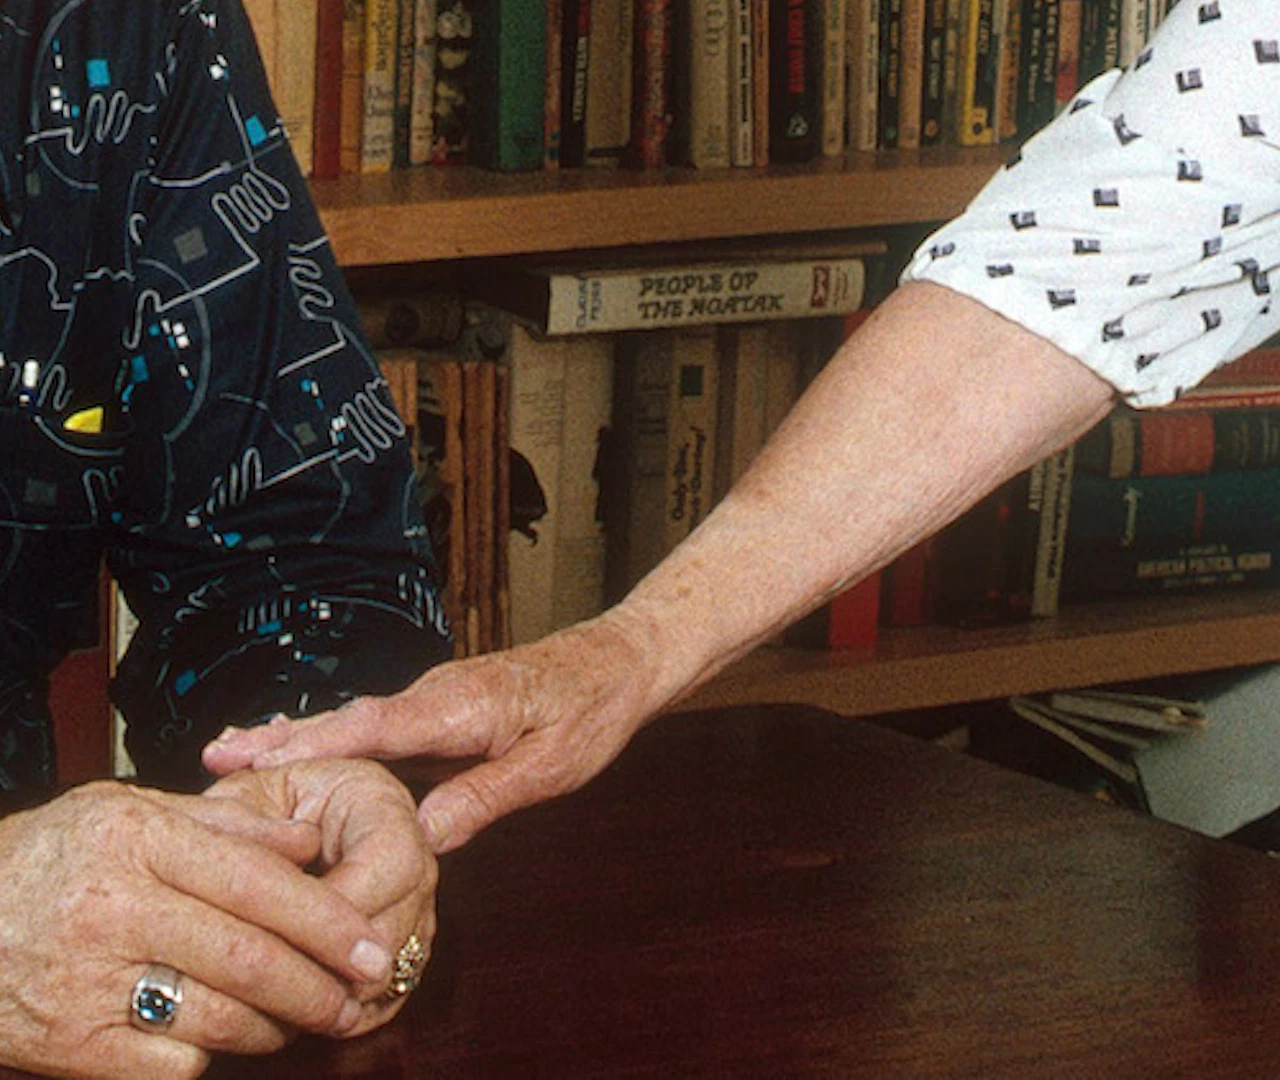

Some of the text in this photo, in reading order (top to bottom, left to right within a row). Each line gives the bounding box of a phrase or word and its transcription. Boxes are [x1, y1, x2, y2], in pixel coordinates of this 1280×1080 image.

[637, 272, 758, 297] PEOPLE OF
[636, 293, 786, 320] THE NOATAK
